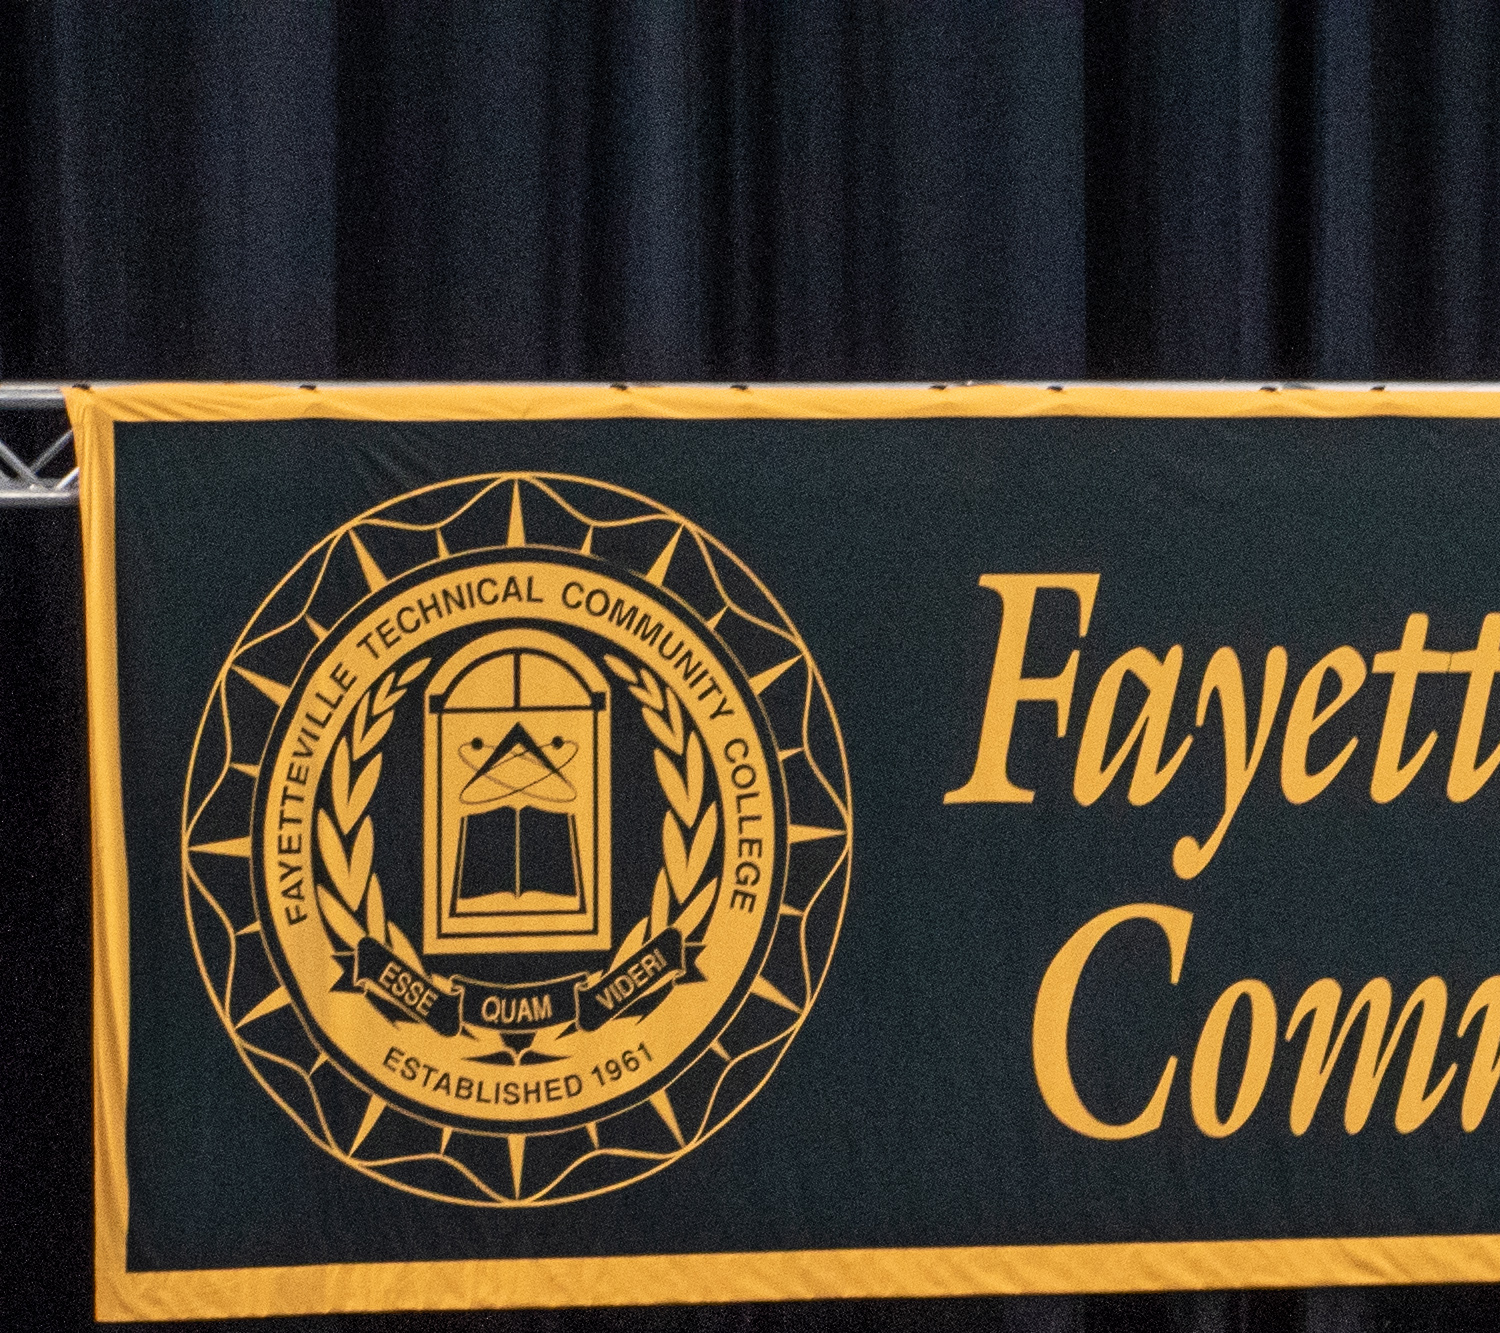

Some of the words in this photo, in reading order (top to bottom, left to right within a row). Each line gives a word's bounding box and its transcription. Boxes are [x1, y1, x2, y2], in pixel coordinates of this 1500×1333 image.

[277, 661, 358, 926] FAYETTEVILLE
[355, 575, 545, 660] TECHNICAL
[561, 580, 735, 721] COMMUNITY
[723, 738, 763, 912] COLLEGE
[378, 961, 439, 1016] ESSE
[481, 994, 553, 1024] QUAM
[595, 949, 668, 1011] VIDERI
[382, 1046, 583, 1105] ESTABLISHED
[590, 1041, 654, 1086] 1961
